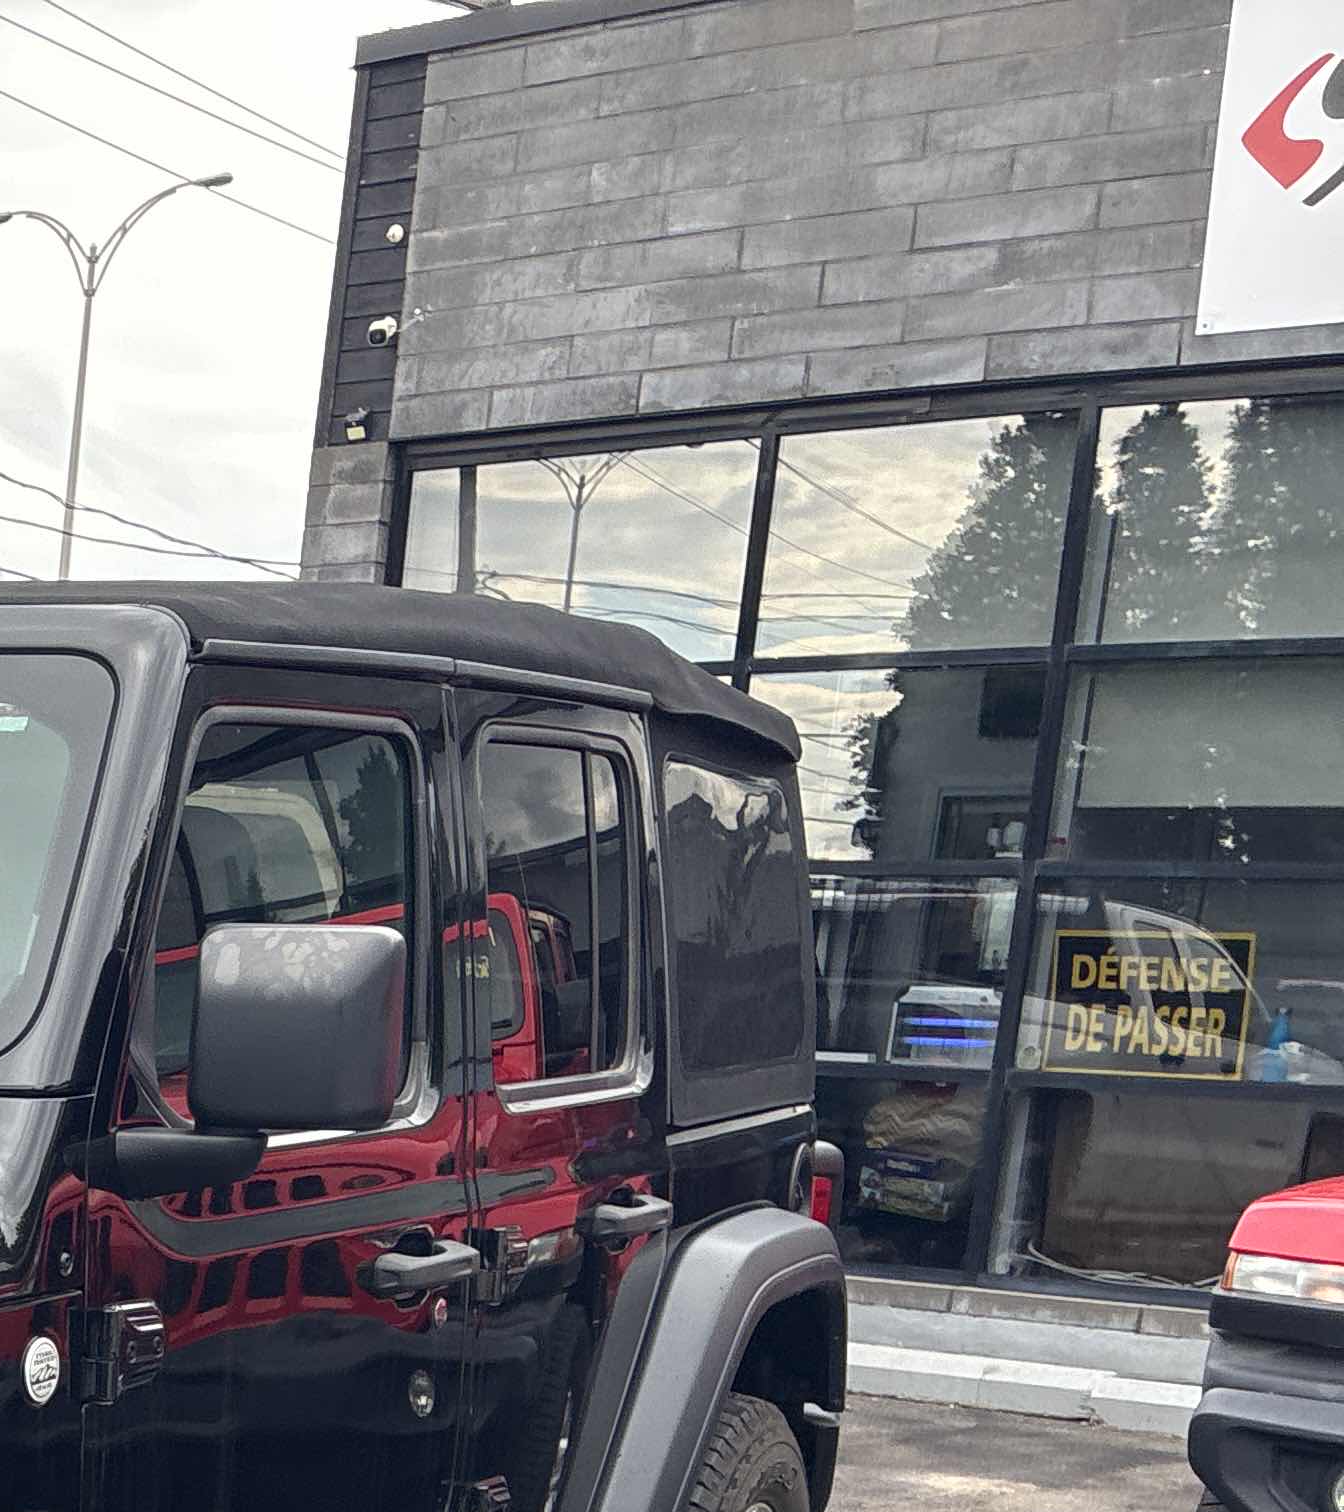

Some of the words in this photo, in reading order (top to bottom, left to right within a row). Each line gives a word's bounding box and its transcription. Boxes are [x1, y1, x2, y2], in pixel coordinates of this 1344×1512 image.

[1070, 946, 1232, 993] DÉFENSE
[1064, 1003, 1108, 1053] DE
[1112, 1004, 1226, 1057] PASSER
